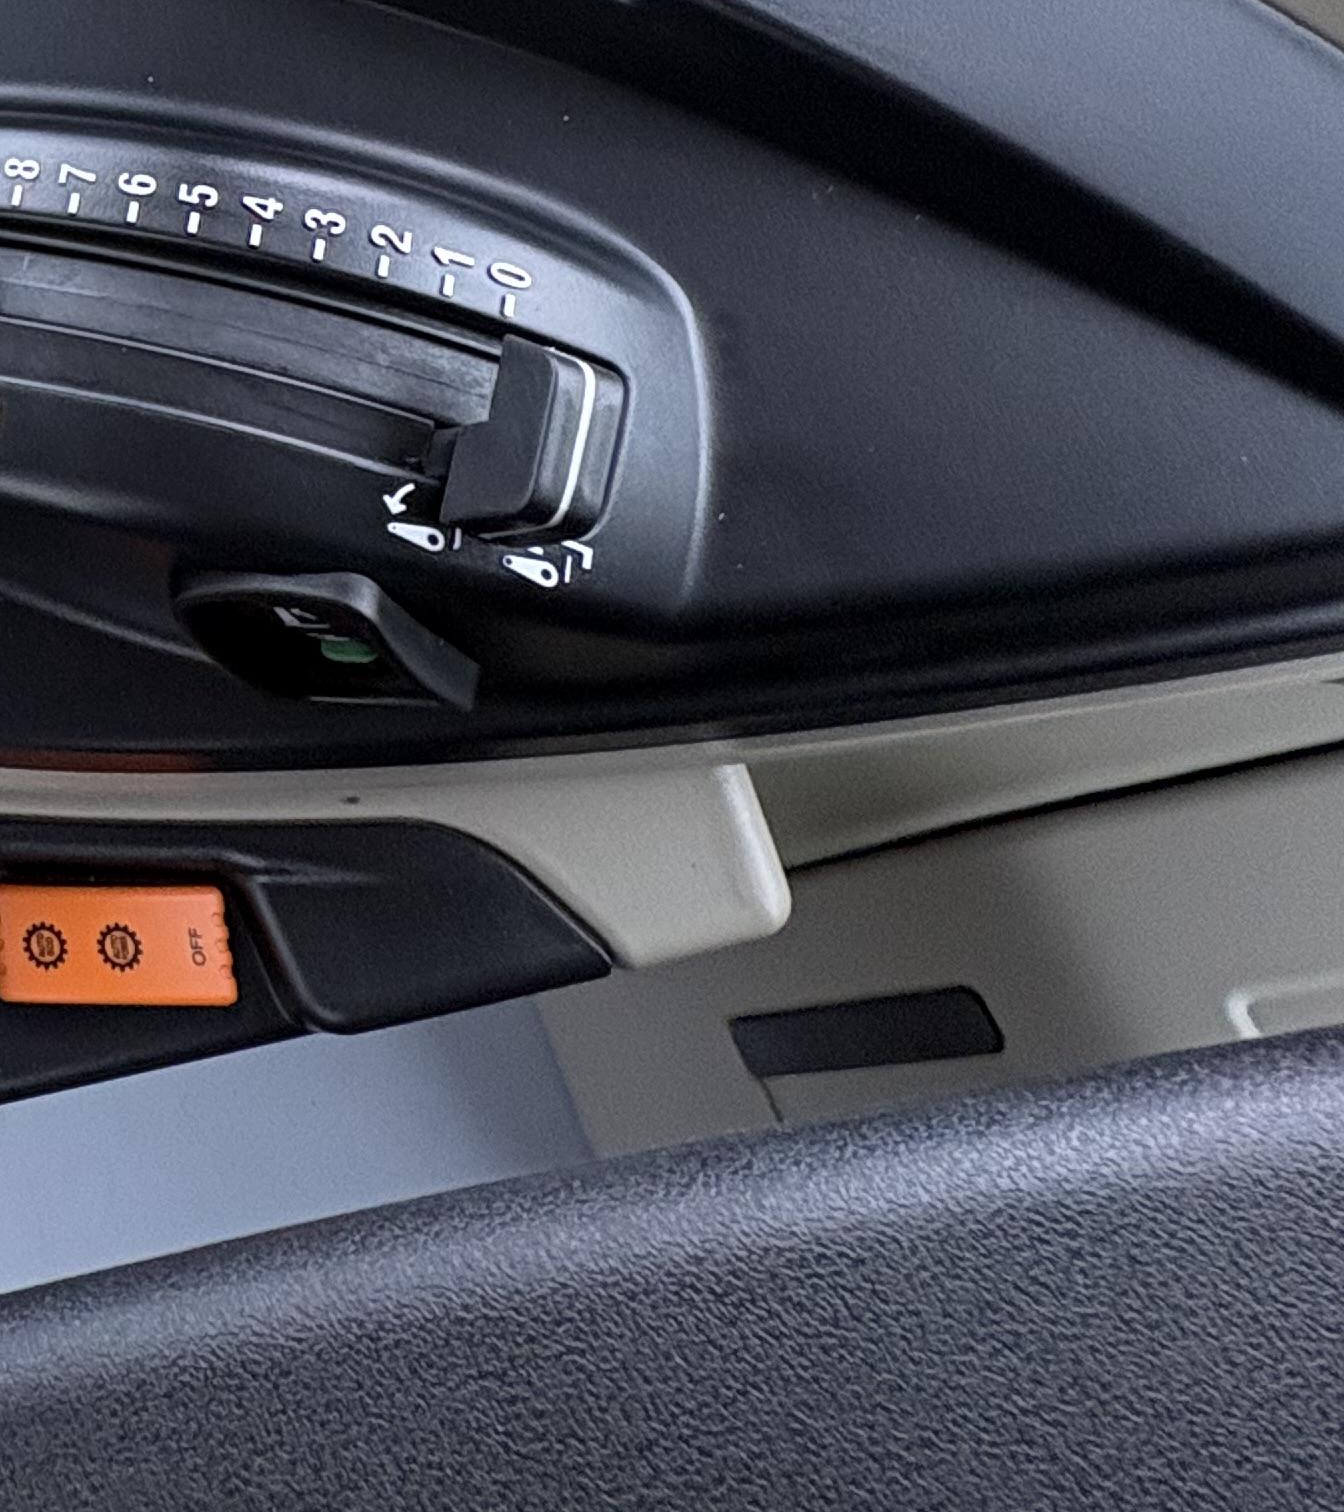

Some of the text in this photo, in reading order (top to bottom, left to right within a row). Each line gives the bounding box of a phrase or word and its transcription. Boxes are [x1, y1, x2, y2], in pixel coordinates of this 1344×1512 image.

[4, 157, 40, 180] 8
[58, 163, 97, 184] 7
[118, 172, 157, 196] 6
[178, 183, 219, 207] 5
[242, 195, 284, 220] 4
[304, 208, 346, 235] 3
[371, 224, 412, 254] 2
[433, 246, 475, 266] 1
[490, 262, 532, 289] 0
[188, 927, 207, 966] OFF
